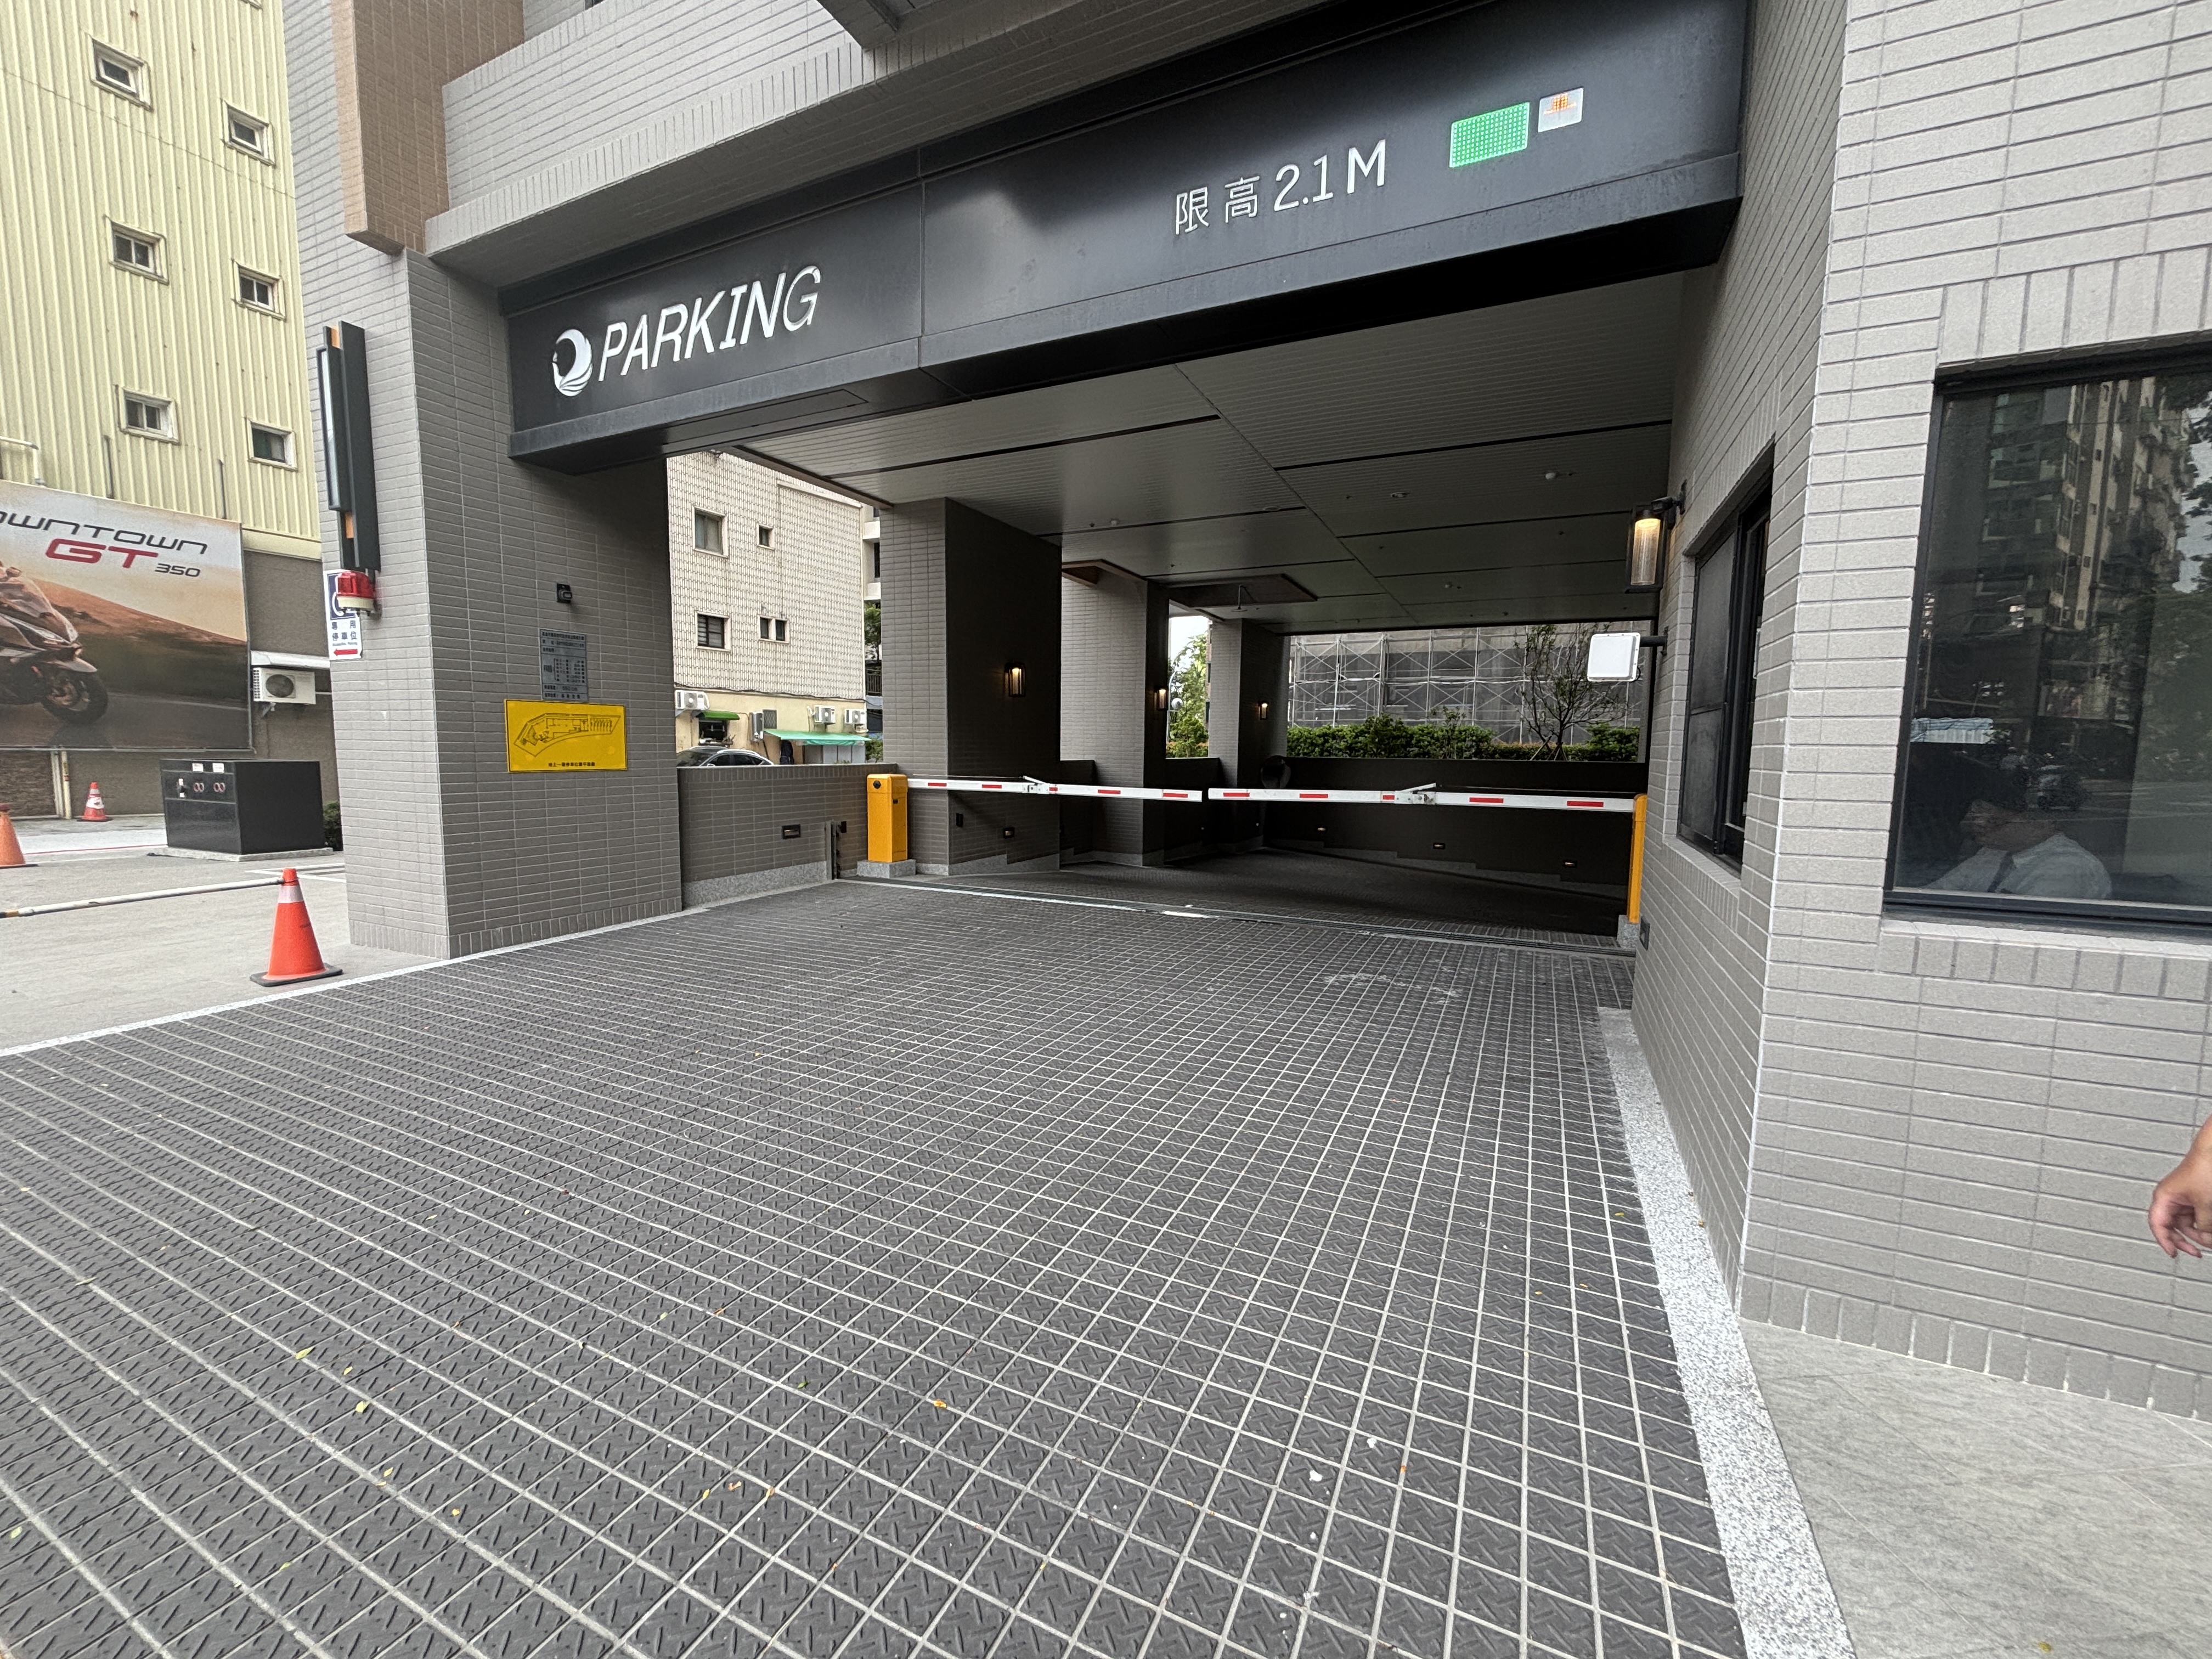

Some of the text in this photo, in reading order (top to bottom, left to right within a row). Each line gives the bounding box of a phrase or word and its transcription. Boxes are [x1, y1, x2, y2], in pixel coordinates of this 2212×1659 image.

[1175, 138, 1387, 236] 限高 2.1M
[598, 265, 822, 382] PARKING
[0, 511, 208, 555] WNTOWN
[46, 538, 201, 578] GT 350
